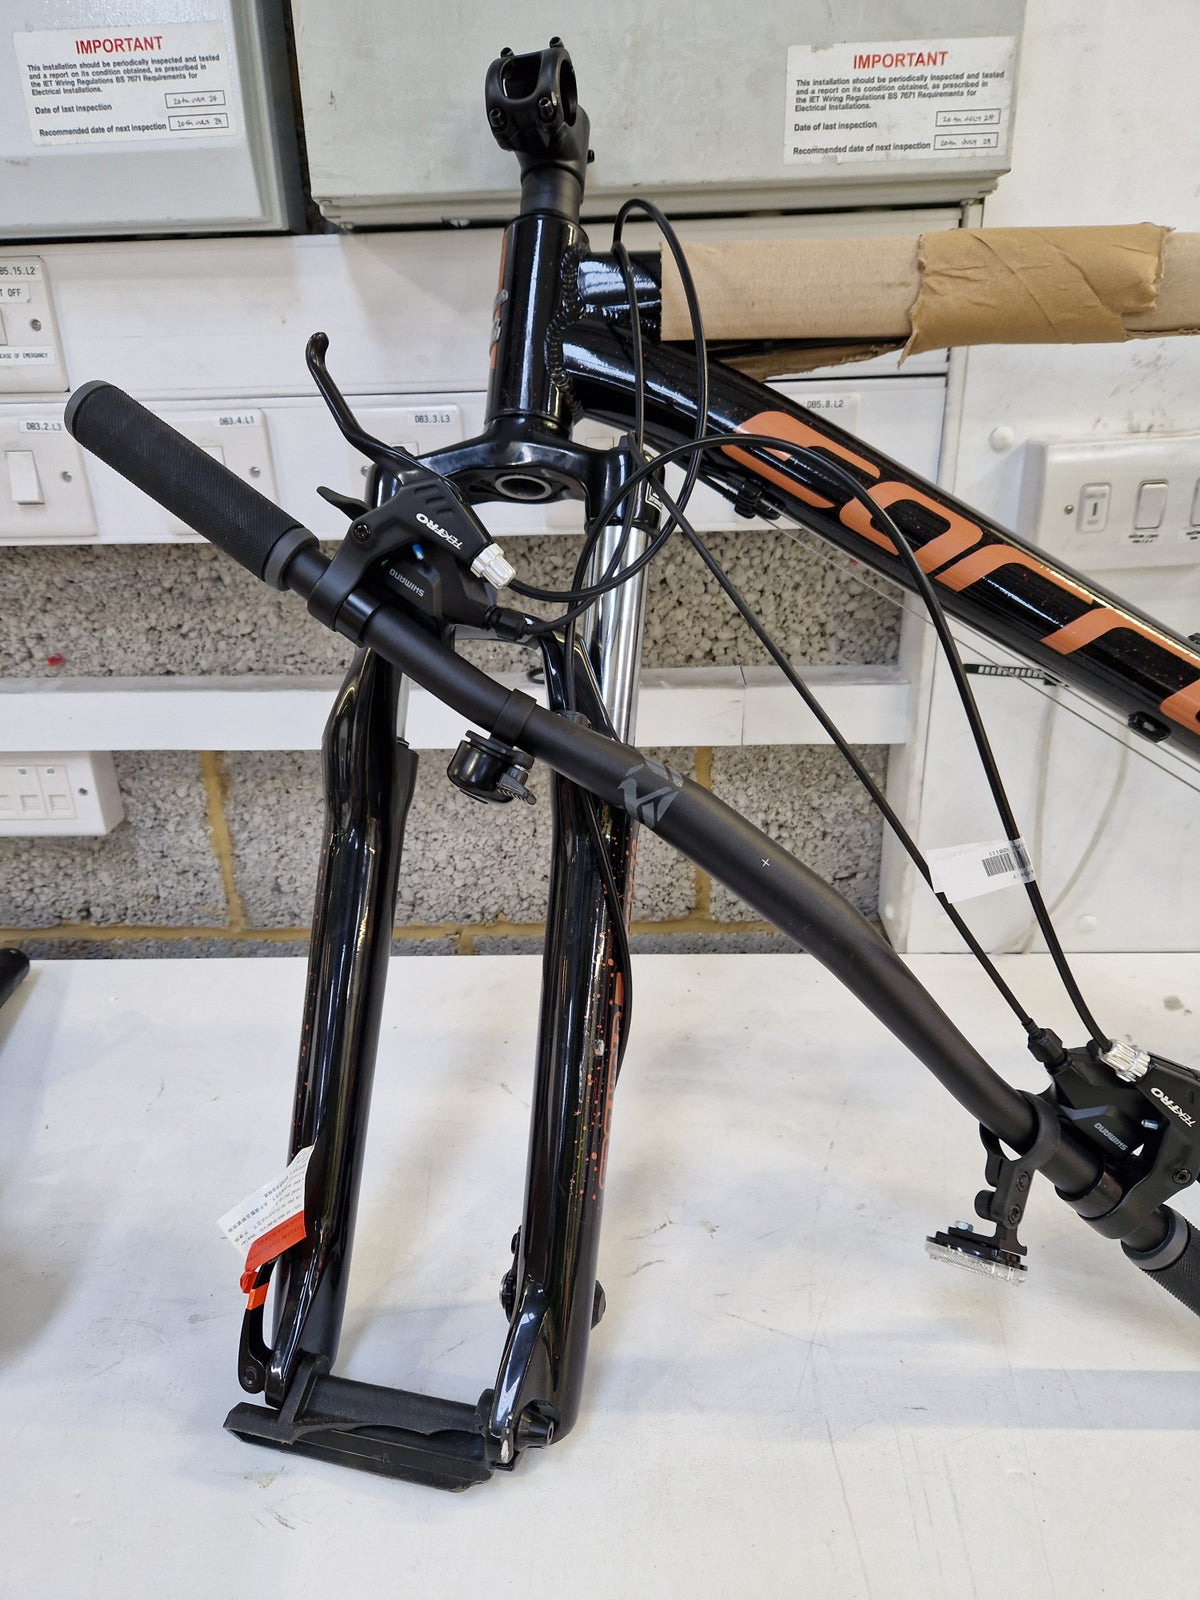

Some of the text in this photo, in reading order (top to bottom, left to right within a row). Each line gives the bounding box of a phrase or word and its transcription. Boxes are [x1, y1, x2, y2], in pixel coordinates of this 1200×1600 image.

[76, 36, 163, 54] IMPORTANT
[27, 64, 41, 72] This
[102, 60, 110, 68] be
[113, 58, 148, 68] periodically
[151, 56, 182, 65] inspected
[853, 51, 948, 70] IMPORTANT
[165, 64, 198, 73] prescribed
[77, 77, 114, 86] Regulations
[143, 73, 186, 82] Requirements
[852, 76, 875, 84] should
[889, 74, 928, 83] periodically
[930, 72, 964, 82] inspected
[32, 88, 60, 96] Electrical
[818, 87, 838, 95] report
[942, 80, 979, 89] prescribed
[822, 95, 843, 103] Wiring
[846, 93, 885, 102] Regulations
[917, 90, 964, 99] Requirements
[35, 106, 51, 114] Date
[76, 104, 112, 113] inspection
[795, 103, 871, 112] Electrical Installations.
[39, 122, 166, 136] Recommended date of next inspection
[823, 122, 836, 130] last
[838, 121, 877, 130] inspection
[793, 145, 847, 155] Recommended
[848, 144, 864, 152] date
[893, 142, 930, 151] inspection
[220, 416, 254, 425] DB3.4.L1
[414, 415, 450, 424] DB3.3.L3
[416, 513, 463, 550] TEKTRO
[389, 568, 425, 597] SHIMANO
[1150, 1087, 1196, 1128] TEKTRO
[1094, 1122, 1128, 1152] SHIMANO
